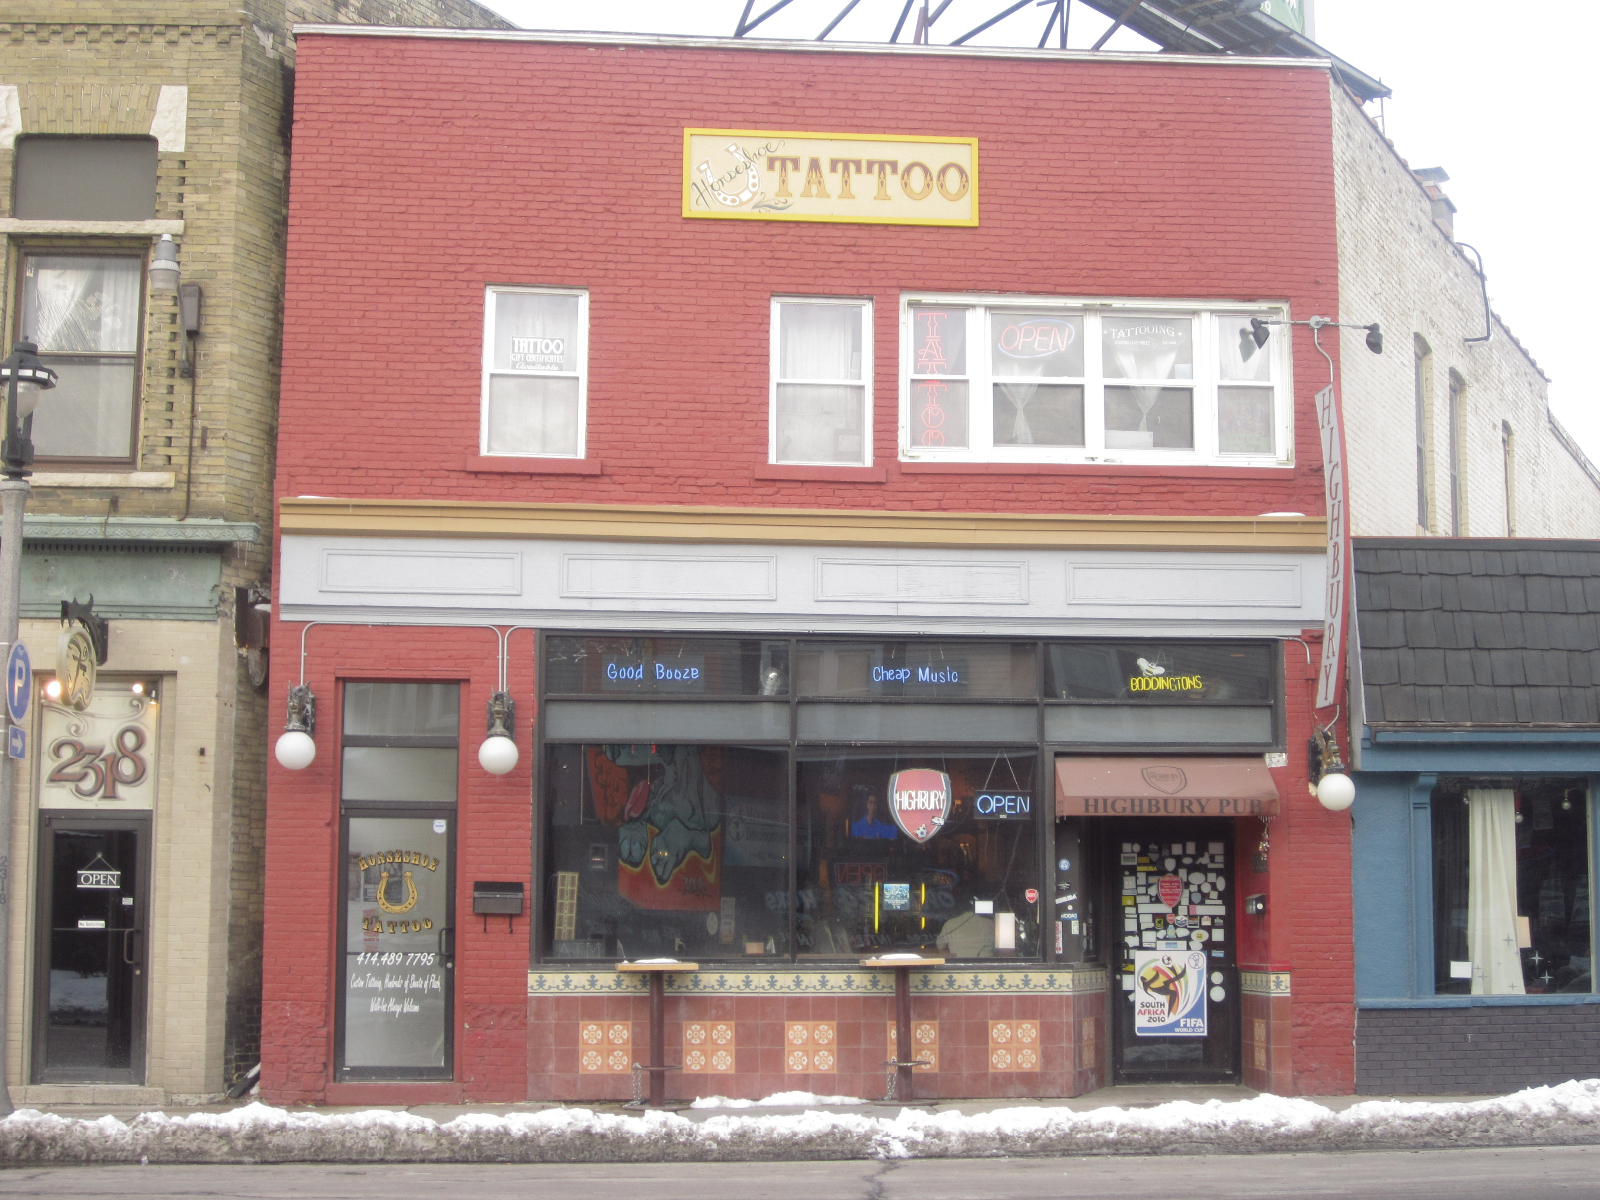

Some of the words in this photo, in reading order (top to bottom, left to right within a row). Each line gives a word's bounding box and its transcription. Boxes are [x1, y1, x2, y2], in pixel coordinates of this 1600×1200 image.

[691, 140, 786, 209] Horseshoe
[767, 155, 969, 202] TATTOO
[1001, 325, 1069, 351] OPEN
[1110, 325, 1175, 338] TATTOOING
[512, 338, 563, 354] TATTOO
[511, 353, 524, 361] GIFT
[526, 354, 563, 363] CERTIFICATES
[1320, 388, 1341, 701] HIGHBURY
[606, 663, 644, 680] Good
[655, 663, 700, 680] Booze
[872, 666, 911, 682] Cheap
[918, 667, 959, 683] Music
[13, 658, 26, 707] P
[1130, 675, 1203, 692] BODDINGTONS
[47, 724, 147, 800] 2318
[896, 790, 946, 811] HIGHBURY
[976, 795, 1030, 814] OPEN
[1084, 798, 1210, 815] HIGHBURY
[1219, 798, 1264, 815] PUB
[356, 849, 440, 873] HORSESHOE
[81, 873, 117, 885] OPEN
[362, 917, 433, 934] TATTOO
[356, 952, 403, 966] 414.489
[405, 952, 436, 966] 7795
[1180, 1018, 1204, 1027] FIFA
